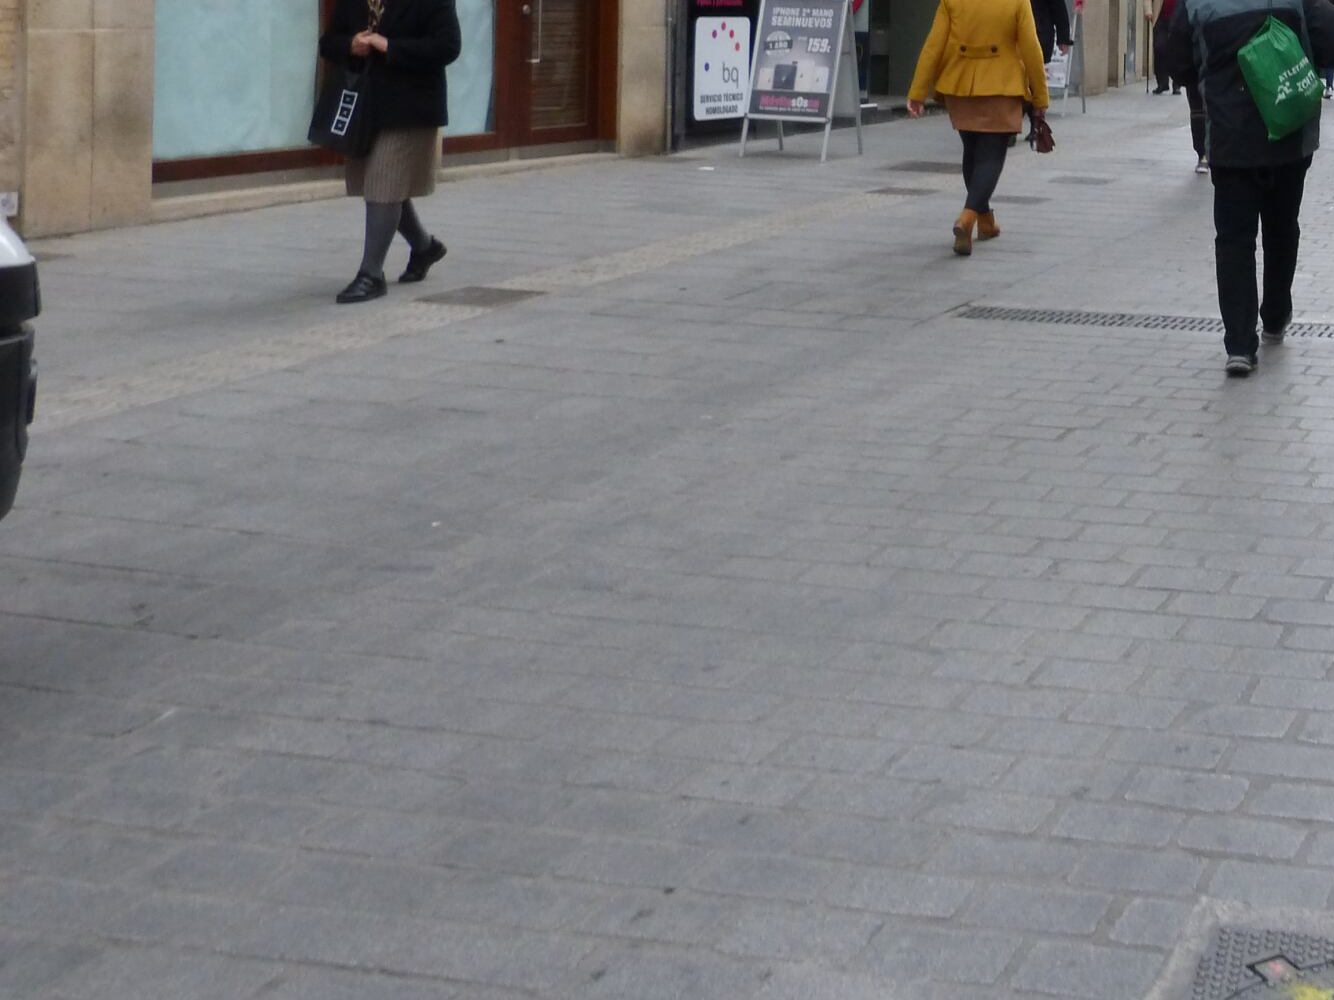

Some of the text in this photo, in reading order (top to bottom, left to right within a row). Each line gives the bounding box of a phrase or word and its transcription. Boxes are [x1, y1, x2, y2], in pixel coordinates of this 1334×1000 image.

[772, 7, 800, 16] IPHONE
[811, 9, 834, 18] MANO
[771, 16, 833, 28] SEMINUEVOS
[722, 61, 739, 88] bq
[705, 105, 738, 115] HOMOLOGADO
